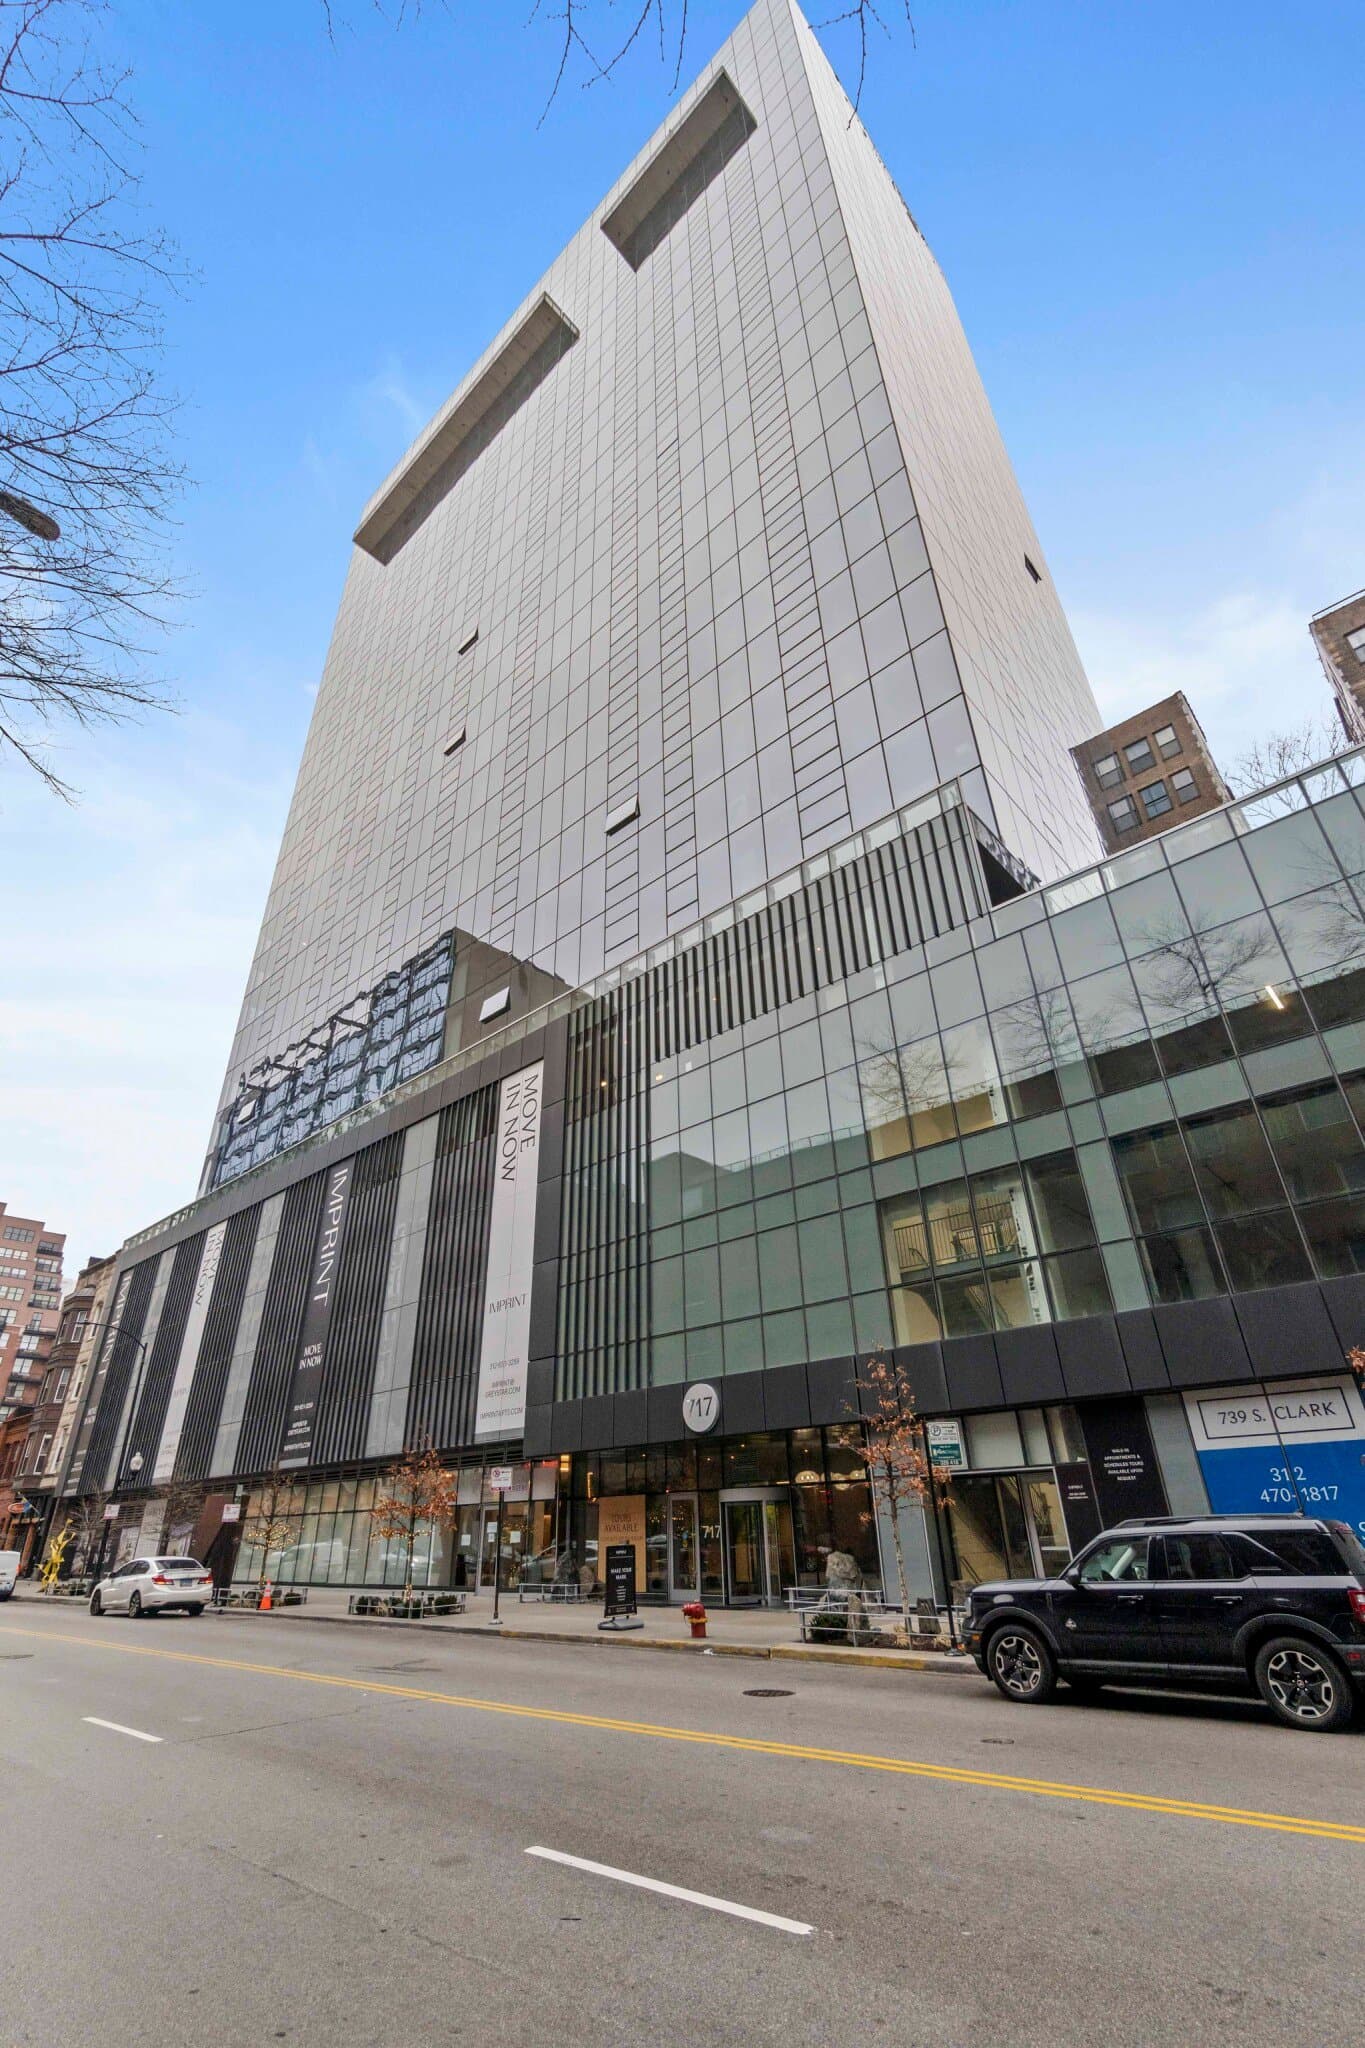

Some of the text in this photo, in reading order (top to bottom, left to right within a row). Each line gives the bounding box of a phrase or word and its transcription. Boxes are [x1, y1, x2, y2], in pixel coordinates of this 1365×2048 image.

[519, 1074, 539, 1153] MOVE
[501, 1083, 520, 1181] IN NOW
[314, 1168, 348, 1306] IMPRINT
[489, 1293, 528, 1314] IMPRINT
[304, 1343, 322, 1356] MOVE
[299, 1354, 323, 1369] IN NOW
[687, 1396, 713, 1417] 717
[1217, 1401, 1337, 1425] 739 S. CLARK
[1270, 1467, 1307, 1482] 312
[1260, 1486, 1339, 1503] 470-1817
[700, 1525, 721, 1539] 717
